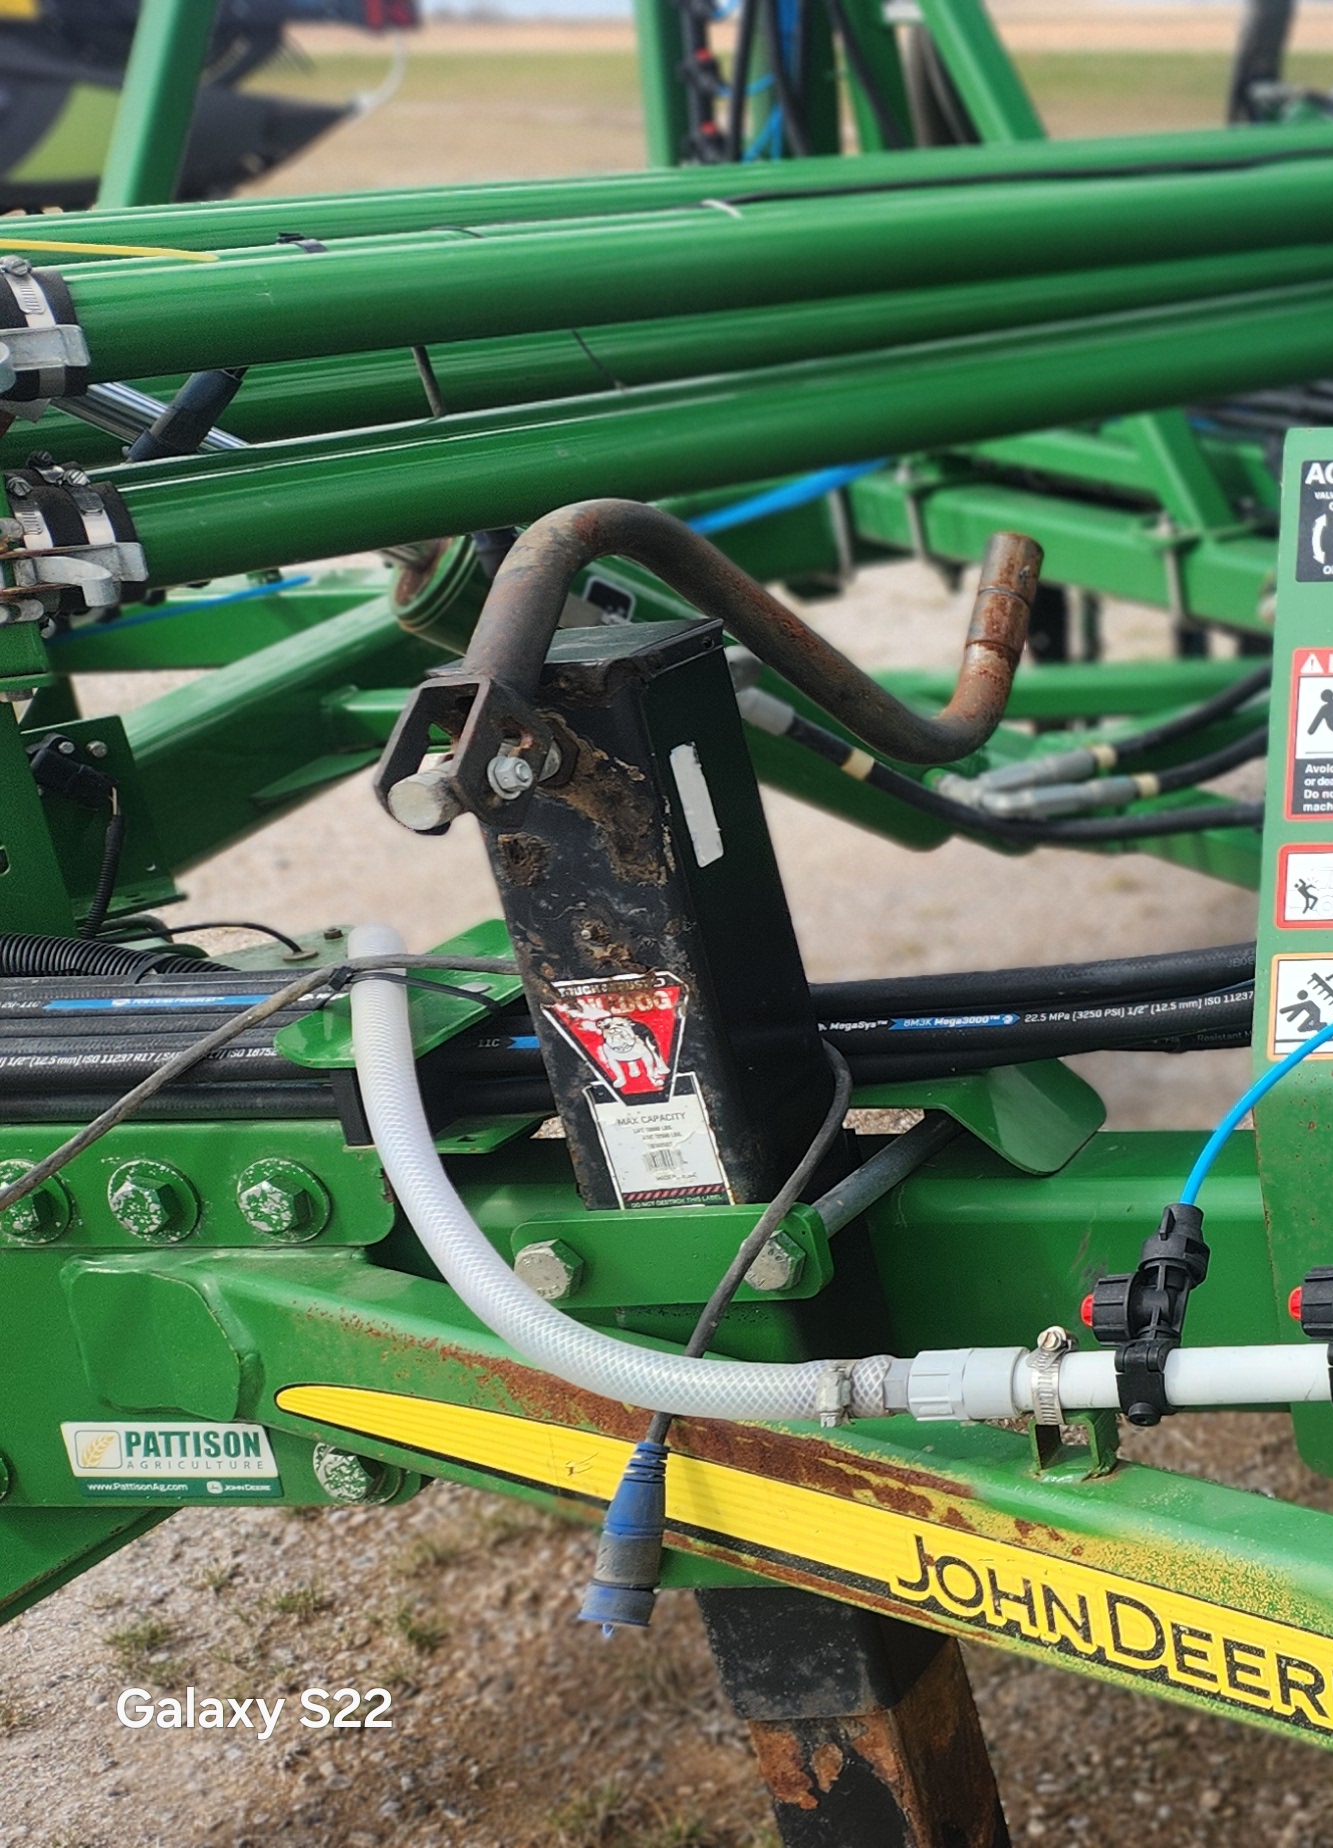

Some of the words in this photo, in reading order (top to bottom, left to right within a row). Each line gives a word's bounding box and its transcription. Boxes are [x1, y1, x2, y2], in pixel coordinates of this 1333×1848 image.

[1304, 777, 1315, 785] or
[1304, 789, 1319, 799] Do
[1025, 1013, 1047, 1022] 22.5
[1049, 1012, 1070, 1021] MPa
[1204, 996, 1221, 1006] ISO
[1223, 991, 1254, 1003] 11237
[82, 1055, 101, 1063] ISO
[101, 1054, 134, 1063] 11237
[616, 1118, 639, 1126] MAX
[641, 1112, 686, 1124] CAPACITY
[124, 1430, 262, 1458] PATTISON
[127, 1460, 264, 1470] AGRICULTURE
[87, 1482, 188, 1492] www.PattisonAg.com
[898, 1533, 1094, 1647] JOHN
